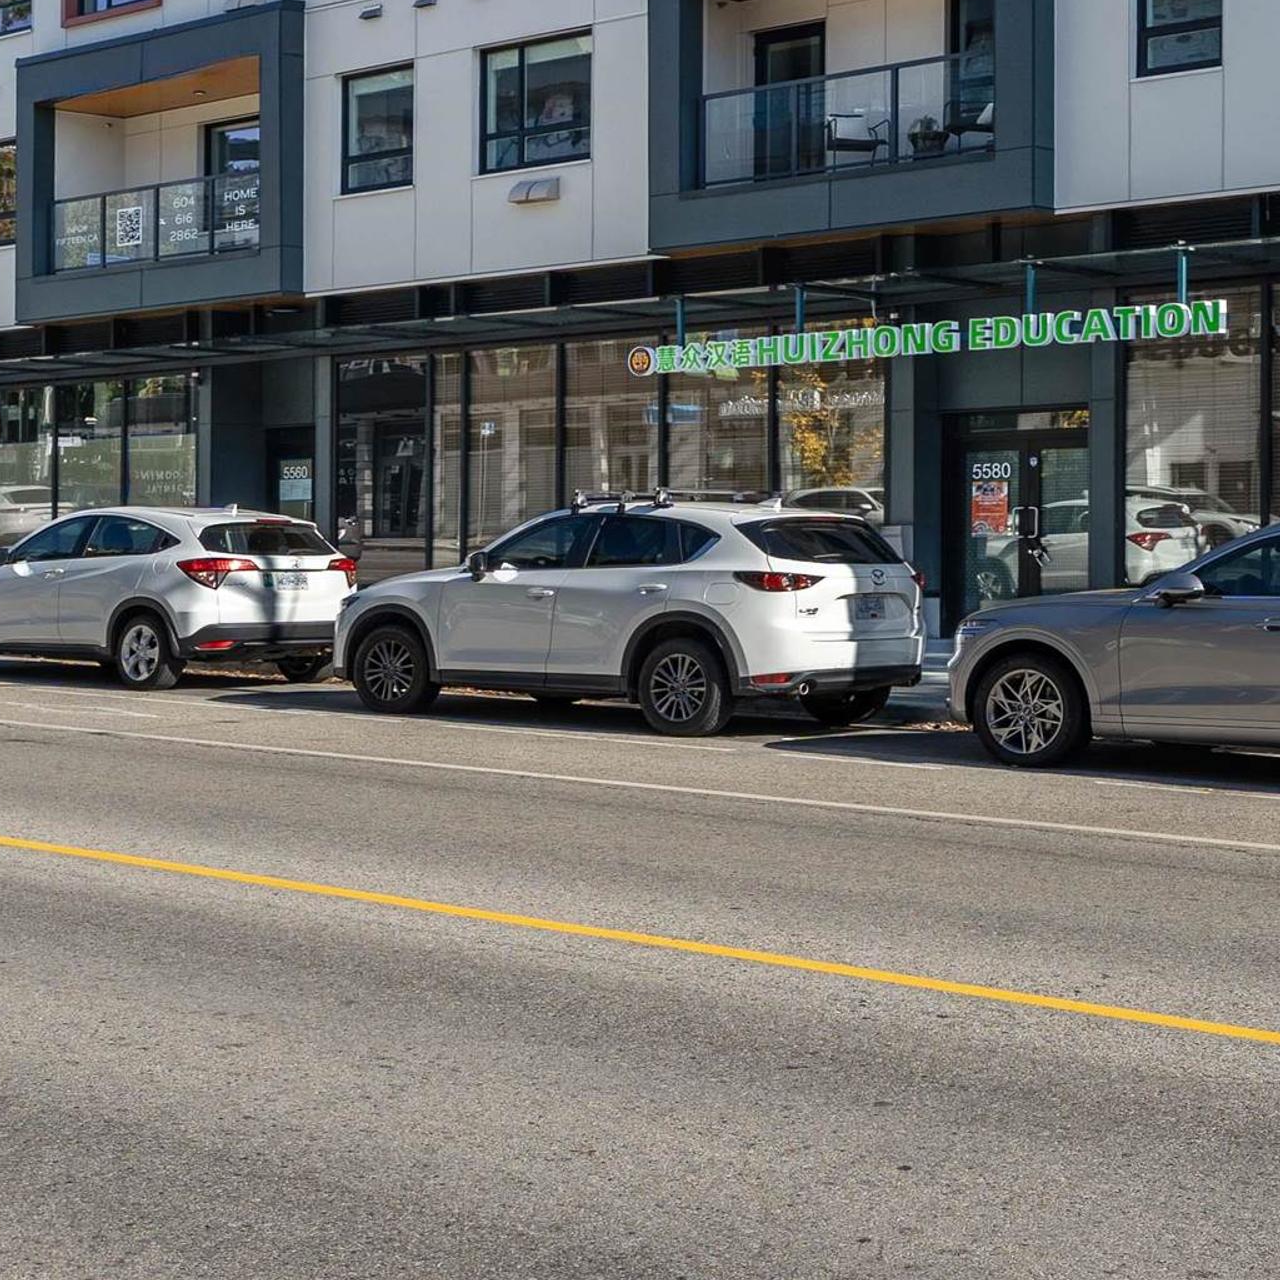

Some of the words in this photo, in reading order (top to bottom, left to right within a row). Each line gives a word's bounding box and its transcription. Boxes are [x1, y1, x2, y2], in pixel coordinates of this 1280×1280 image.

[224, 187, 258, 201] HOME
[173, 196, 194, 209] 604
[235, 204, 246, 216] IS
[175, 212, 193, 225] 616
[226, 218, 256, 231] HERE
[170, 228, 198, 241] 2862
[757, 321, 960, 366] HUIZHONG
[969, 299, 1227, 350] EDUCATION
[655, 342, 753, 372] 慧众汉语
[283, 465, 308, 479] 5560
[972, 462, 1011, 480] 5580
